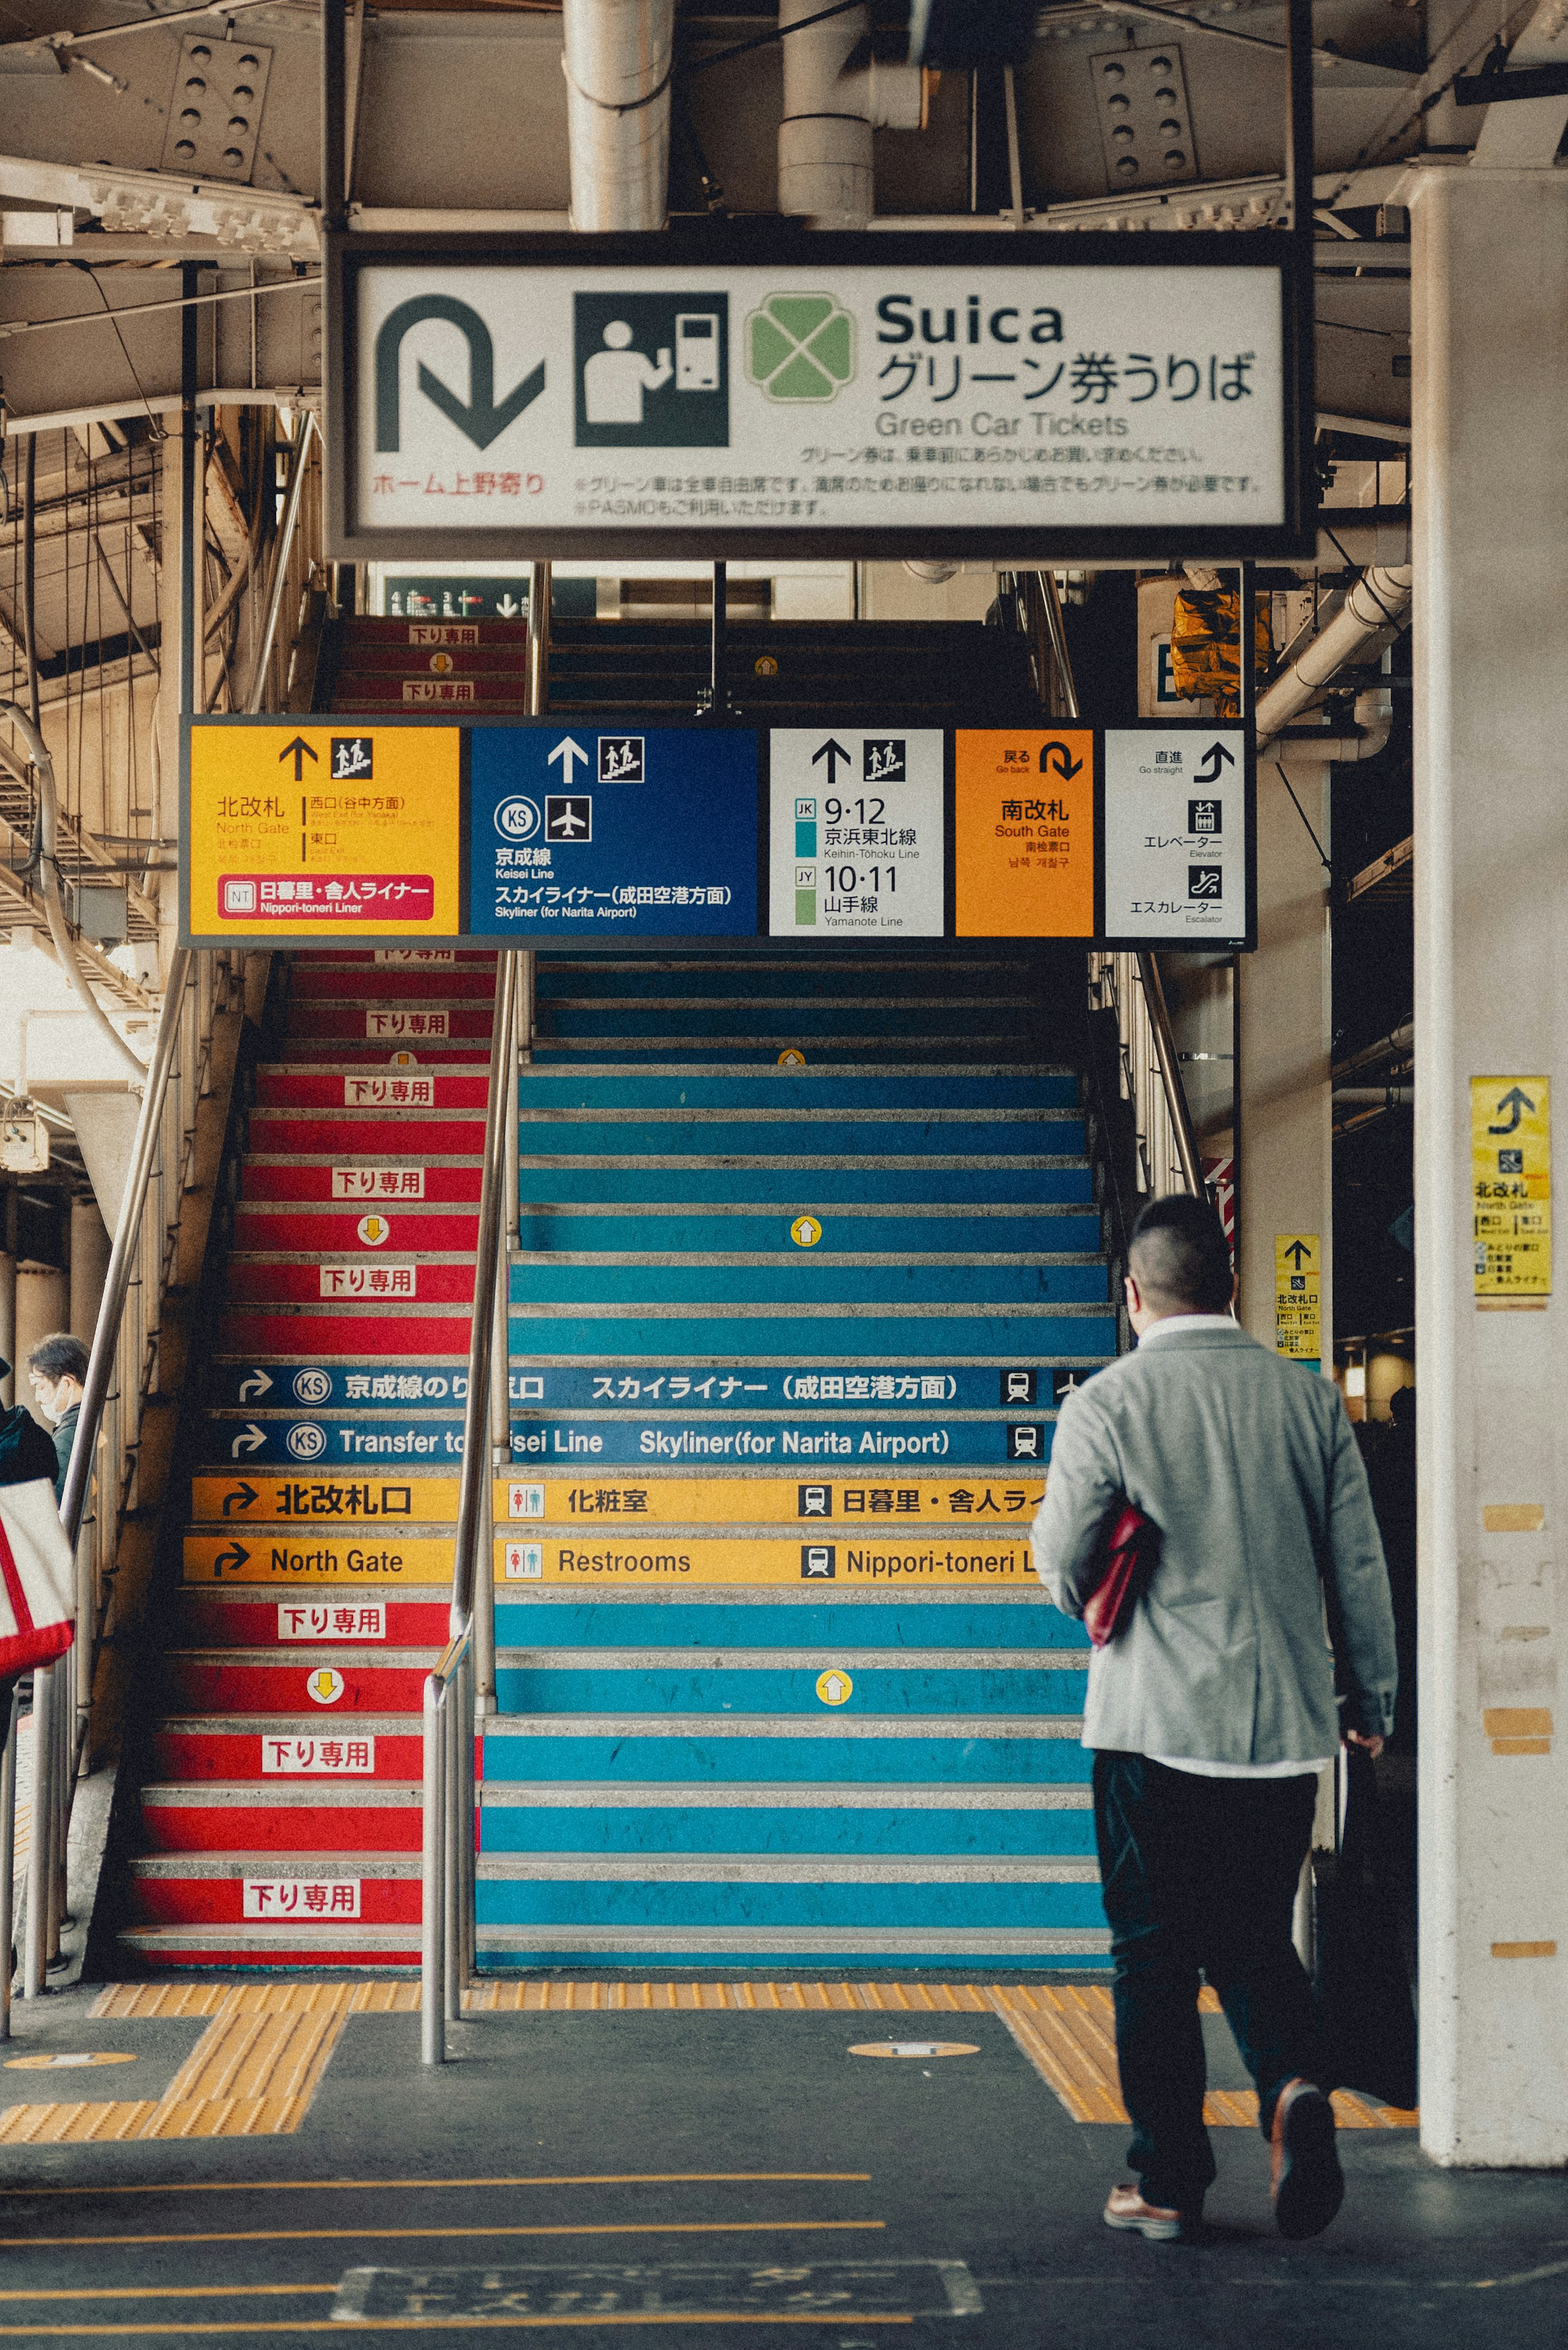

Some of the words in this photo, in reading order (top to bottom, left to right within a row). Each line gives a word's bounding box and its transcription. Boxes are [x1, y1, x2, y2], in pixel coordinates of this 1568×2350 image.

[876, 293, 1065, 343] Suica
[878, 351, 1256, 404] グリーン券うりば
[875, 412, 960, 437] Green
[971, 412, 1019, 437] Car
[1031, 412, 1129, 437] Tickets
[372, 472, 544, 496] ホーム上野寄り
[412, 628, 475, 643] 下り専用
[406, 684, 471, 699] 下り専用
[1004, 751, 1030, 763] 戻る
[1155, 751, 1183, 764] 直進
[1010, 765, 1030, 773] back
[1153, 766, 1183, 775] straight
[217, 796, 285, 817] 北改札
[310, 797, 405, 809] 西口（谷中方面）
[798, 804, 812, 814] JK
[1002, 800, 1069, 821] 南改札
[508, 810, 526, 827] KS
[217, 823, 253, 834] North
[258, 823, 289, 834] Gate
[825, 828, 917, 845] 京浜東北線
[995, 826, 1033, 836] South
[1038, 826, 1069, 836] Gate
[310, 833, 336, 845] 東口
[1144, 836, 1222, 848] エレベーター
[495, 848, 551, 866] 京成線
[899, 850, 919, 859] Line
[495, 869, 528, 878] Keisei
[532, 869, 554, 878] Line
[798, 872, 812, 881] JY
[232, 891, 249, 902] NT
[261, 881, 429, 899] 日暮里・舎人ライナー
[495, 886, 732, 905] スカイライナー（成田空港方面）
[261, 902, 333, 914] Nippori-toneri
[336, 903, 362, 913] Liner
[495, 907, 537, 919] Skyliner
[541, 907, 559, 918] (for
[562, 907, 594, 917] Narita
[597, 907, 636, 919] Airport)
[825, 896, 878, 913] 山手線
[1131, 902, 1222, 913] エスカレーター
[825, 917, 877, 926] Yamanote
[881, 917, 903, 926] Line
[371, 1014, 445, 1034] 下り専用
[350, 1081, 429, 1102] 下り専用
[337, 1172, 420, 1193] 下り専用
[326, 1269, 411, 1292] 下り専用
[1277, 1294, 1318, 1304] 北改札口
[301, 1378, 322, 1395] KS
[593, 1376, 957, 1400] スカイライナー（成田空港方面）
[295, 1433, 318, 1449] KS
[340, 1430, 438, 1453] Transfer
[555, 1431, 602, 1453] Line
[783, 1431, 852, 1454] Narita
[859, 1430, 949, 1458] Airport)
[276, 1484, 411, 1515] 北改札口
[568, 1489, 648, 1513] 化粧室
[271, 1548, 339, 1571] North
[347, 1549, 403, 1572] Gate
[559, 1550, 691, 1572] Restrooms
[848, 1551, 1015, 1578] Nippori-toneri
[283, 1608, 379, 1634] 下り専用
[268, 1741, 369, 1767] 下り専用
[250, 1885, 354, 1912] 下り専用
